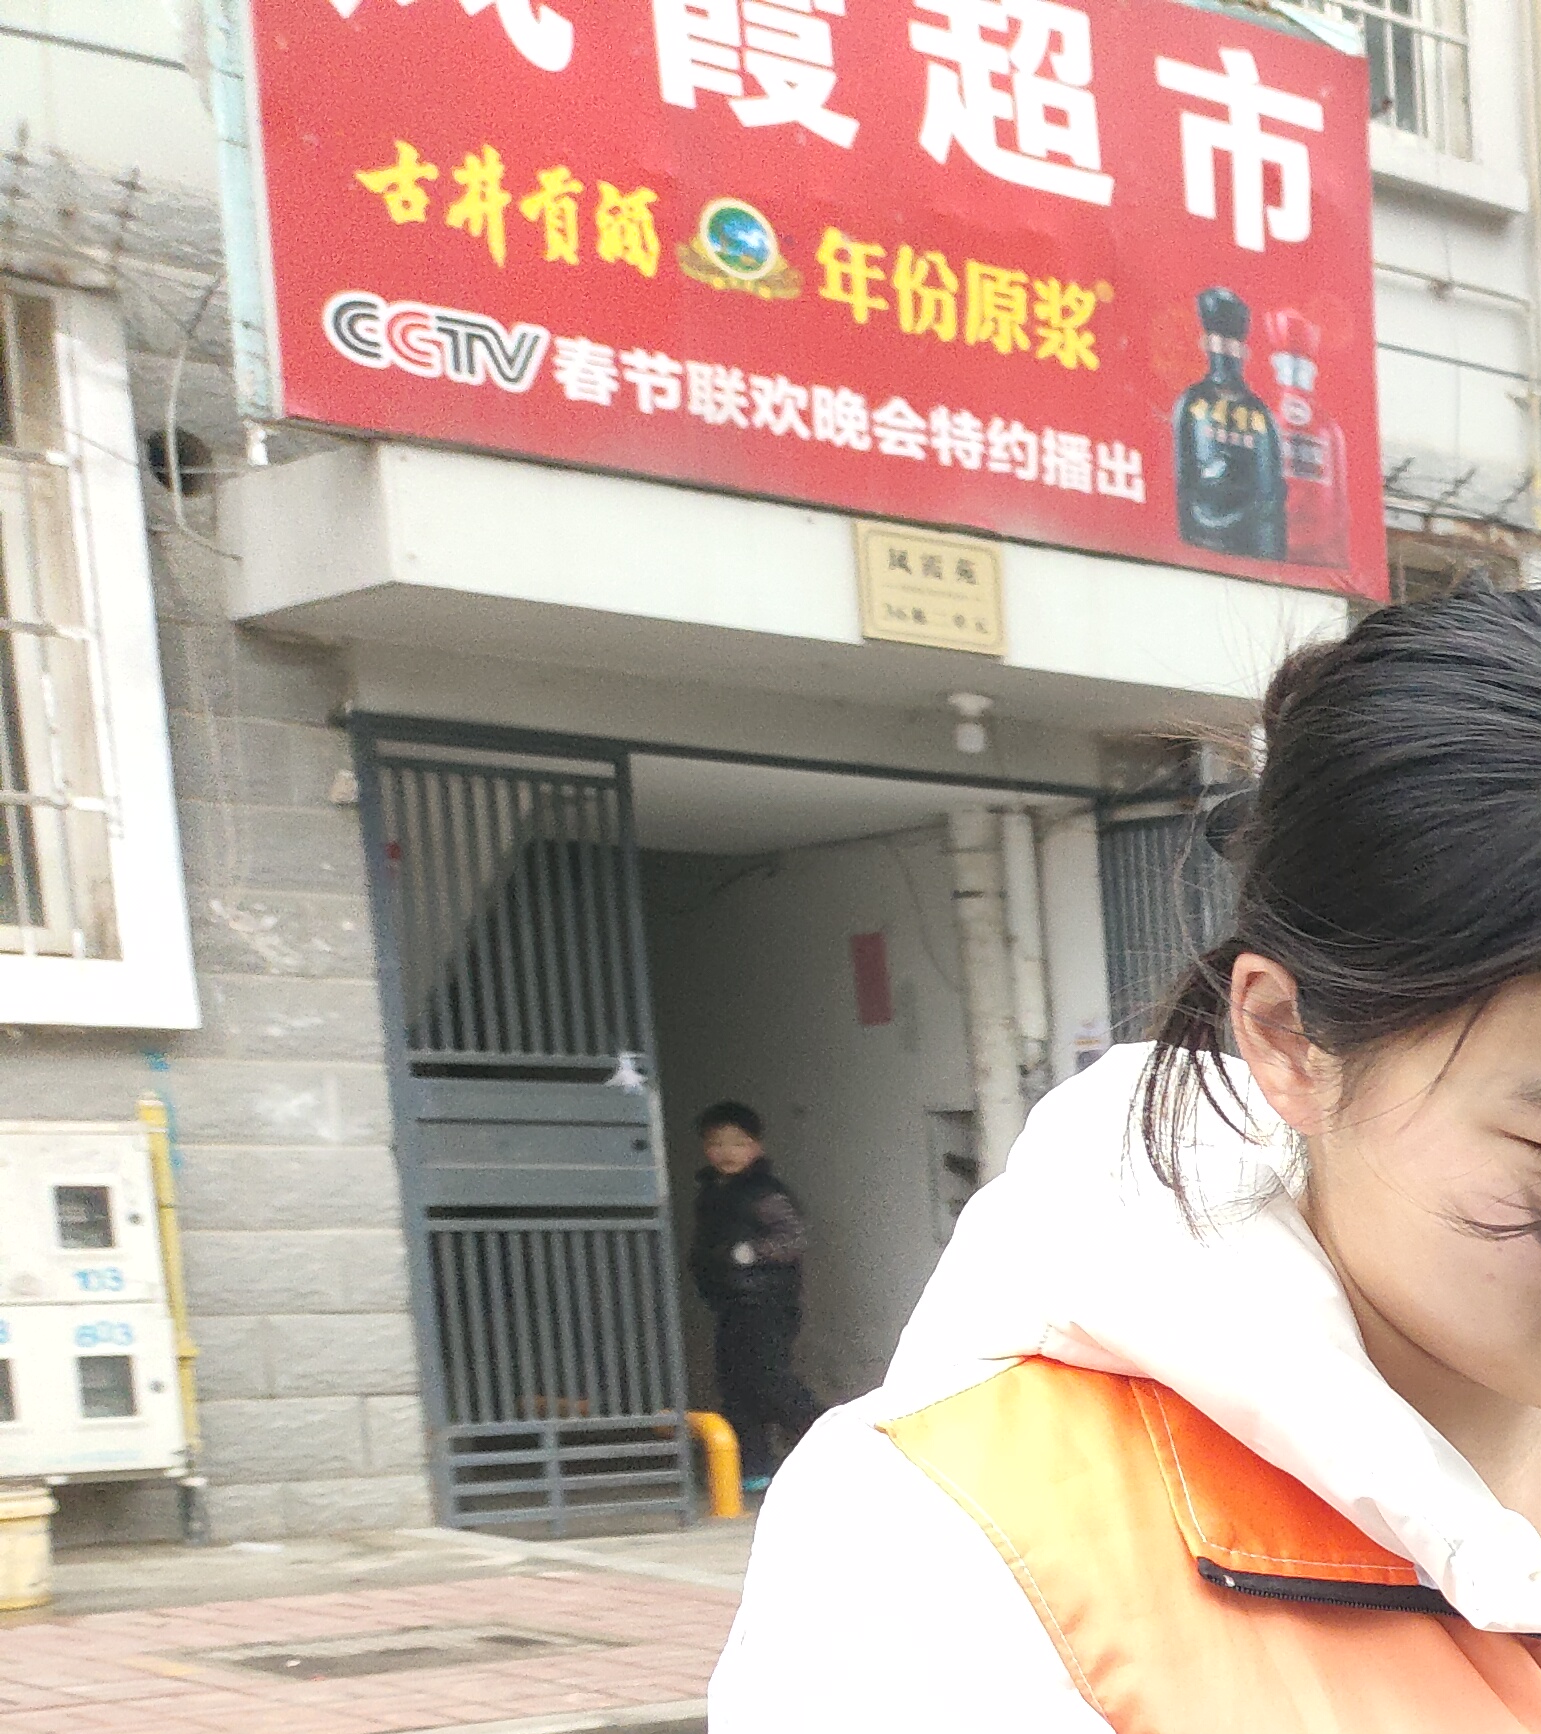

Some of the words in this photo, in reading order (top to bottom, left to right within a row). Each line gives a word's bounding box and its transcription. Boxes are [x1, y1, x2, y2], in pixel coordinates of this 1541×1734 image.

[354, 139, 660, 278] 古井贡酒
[816, 227, 1101, 371] 年份原浆
[322, 290, 554, 394] CCTV
[553, 336, 1147, 505] 春节联欢晚会特约播出
